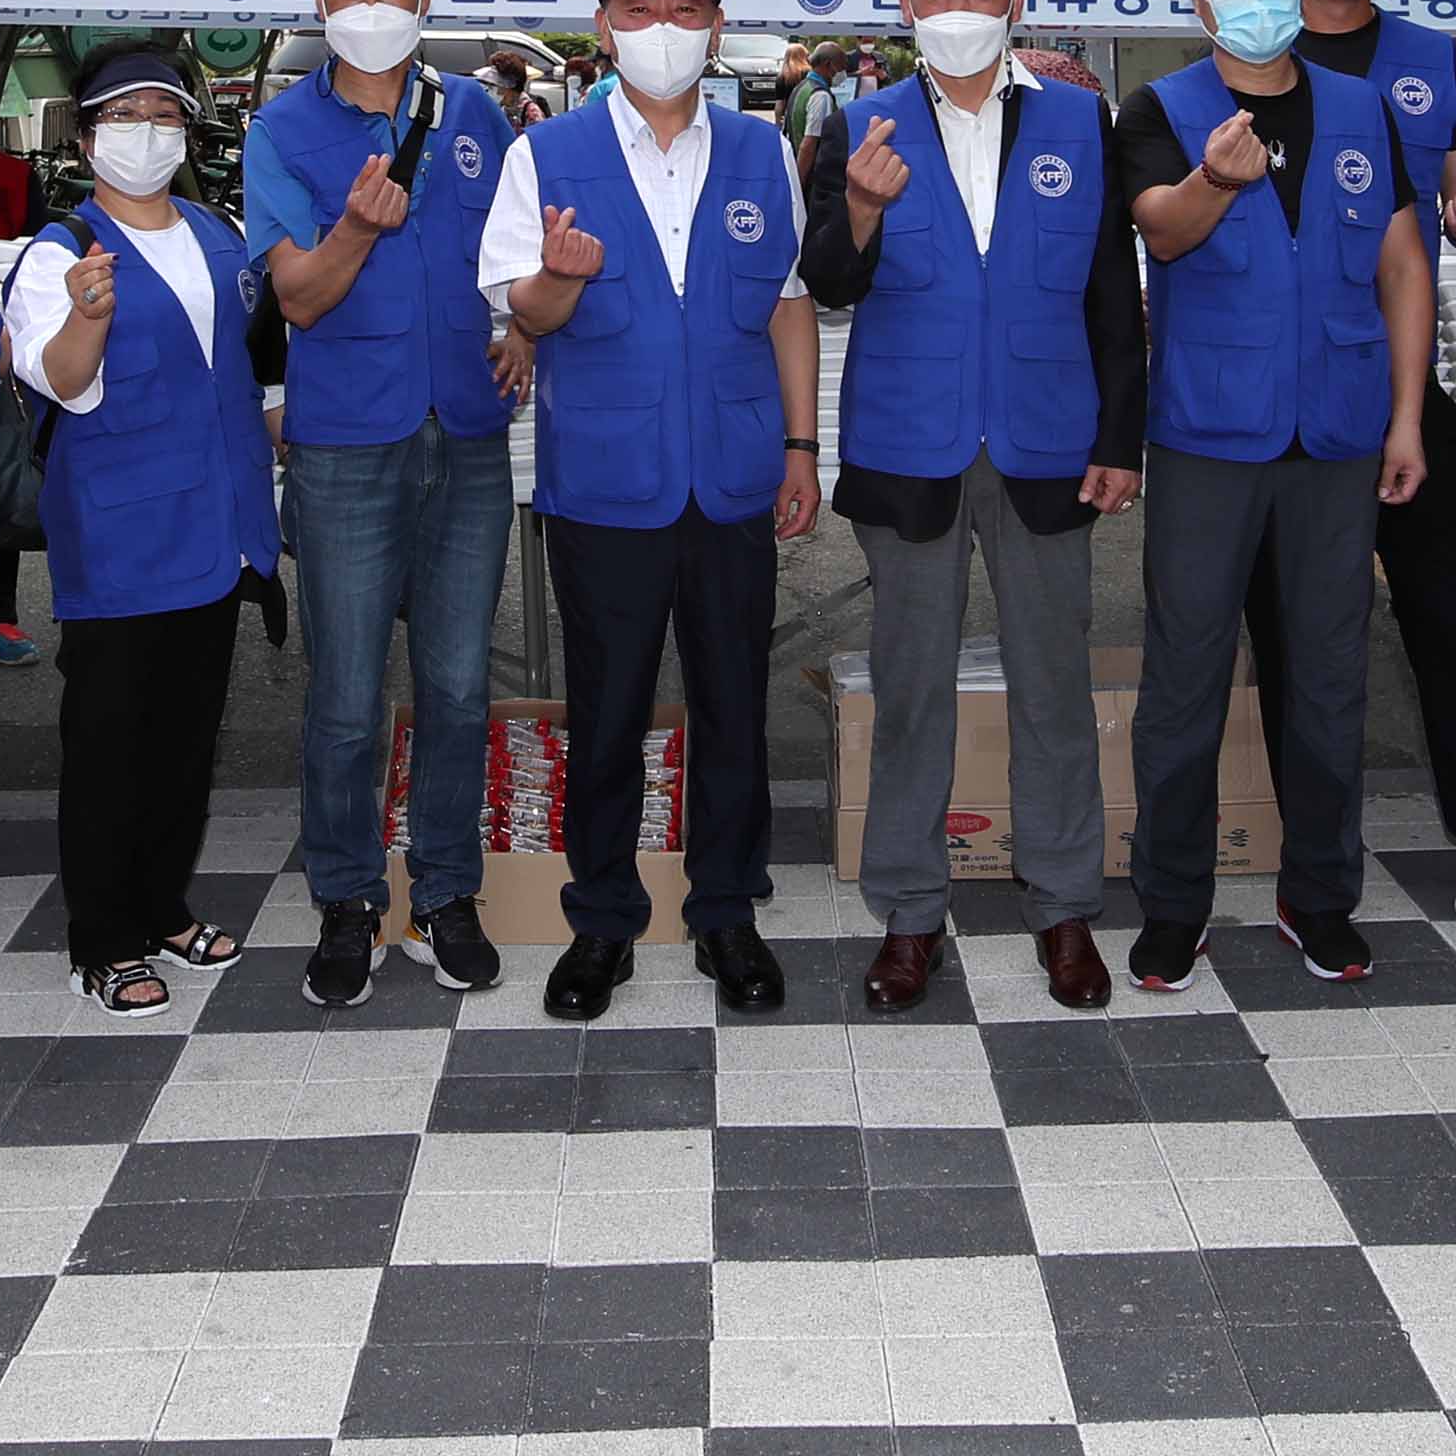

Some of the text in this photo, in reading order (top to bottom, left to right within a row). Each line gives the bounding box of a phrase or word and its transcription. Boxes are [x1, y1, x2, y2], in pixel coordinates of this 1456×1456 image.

[1401, 90, 1426, 103] KFF
[1038, 171, 1064, 183] KFF
[733, 215, 757, 229] KFF
